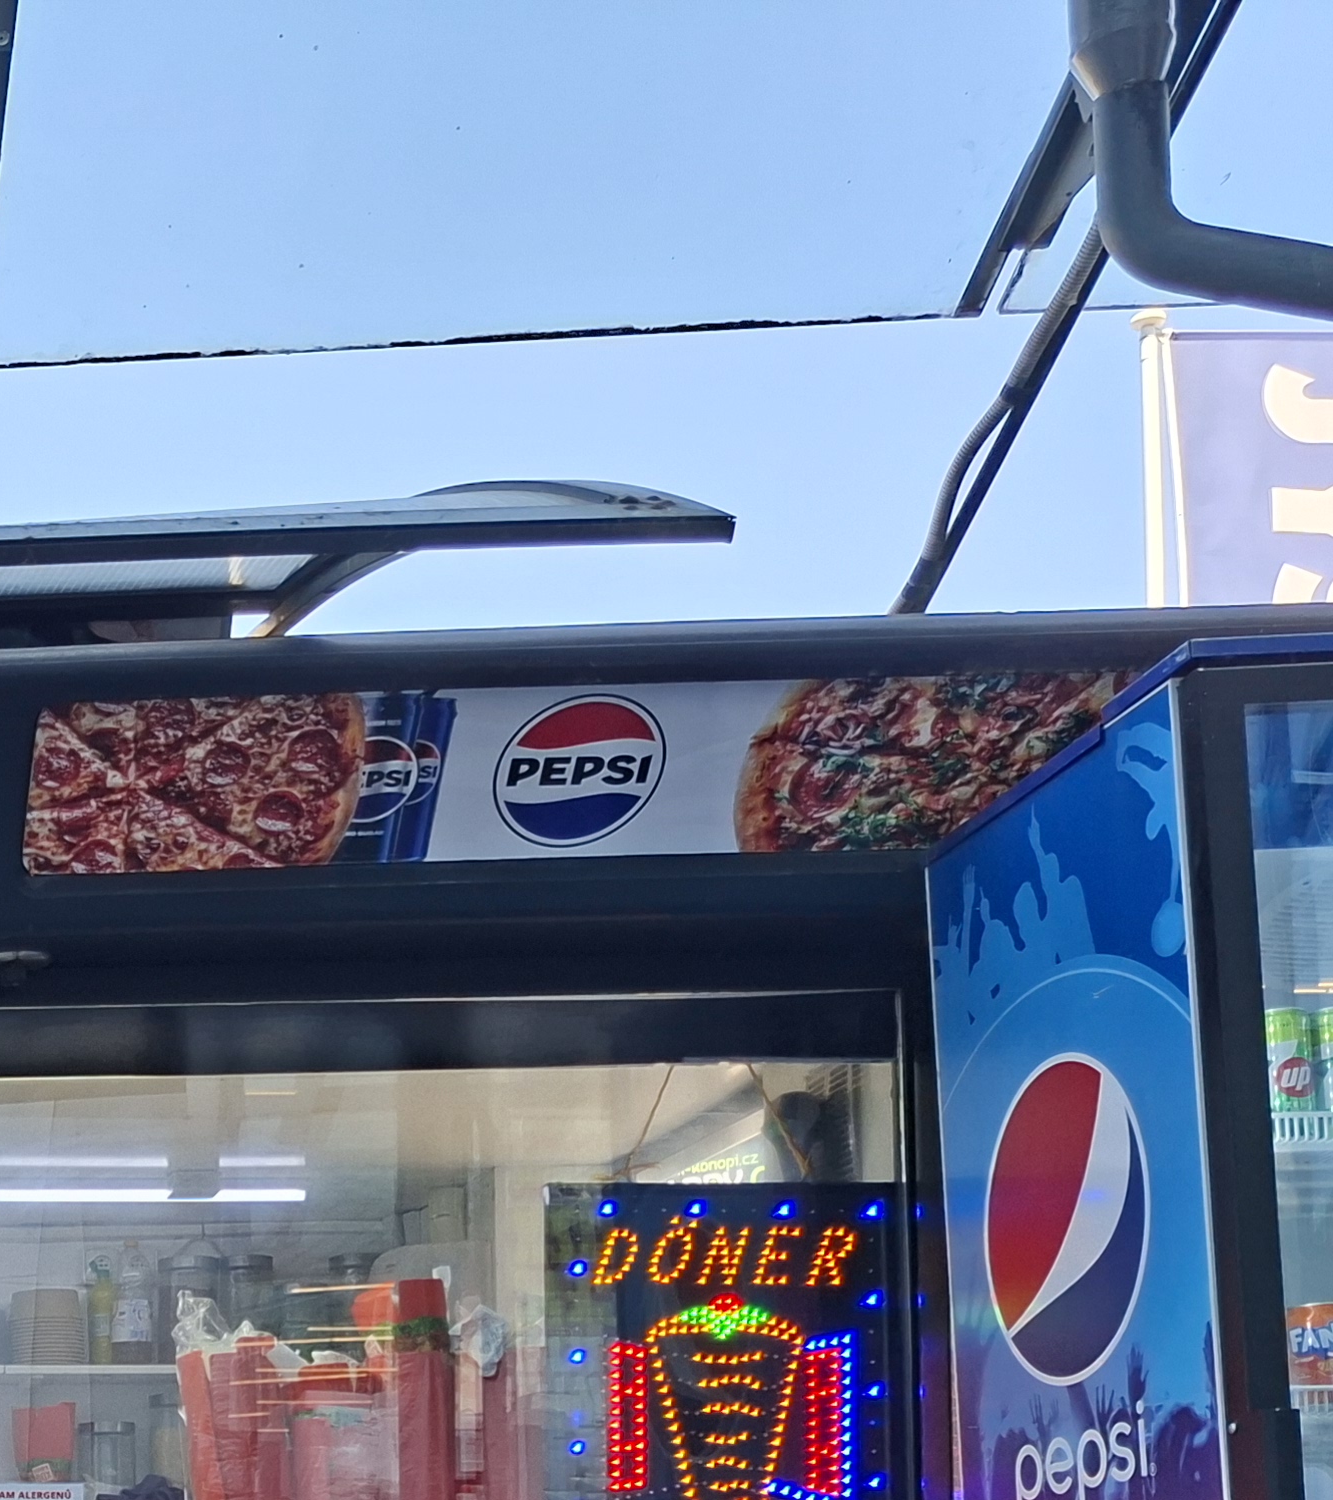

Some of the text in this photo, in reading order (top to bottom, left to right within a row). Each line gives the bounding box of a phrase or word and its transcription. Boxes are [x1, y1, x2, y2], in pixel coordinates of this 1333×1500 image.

[505, 754, 652, 787] PEPSI
[591, 1214, 859, 1287] DÖNER
[18, 1489, 72, 1499] ALERGENŮ
